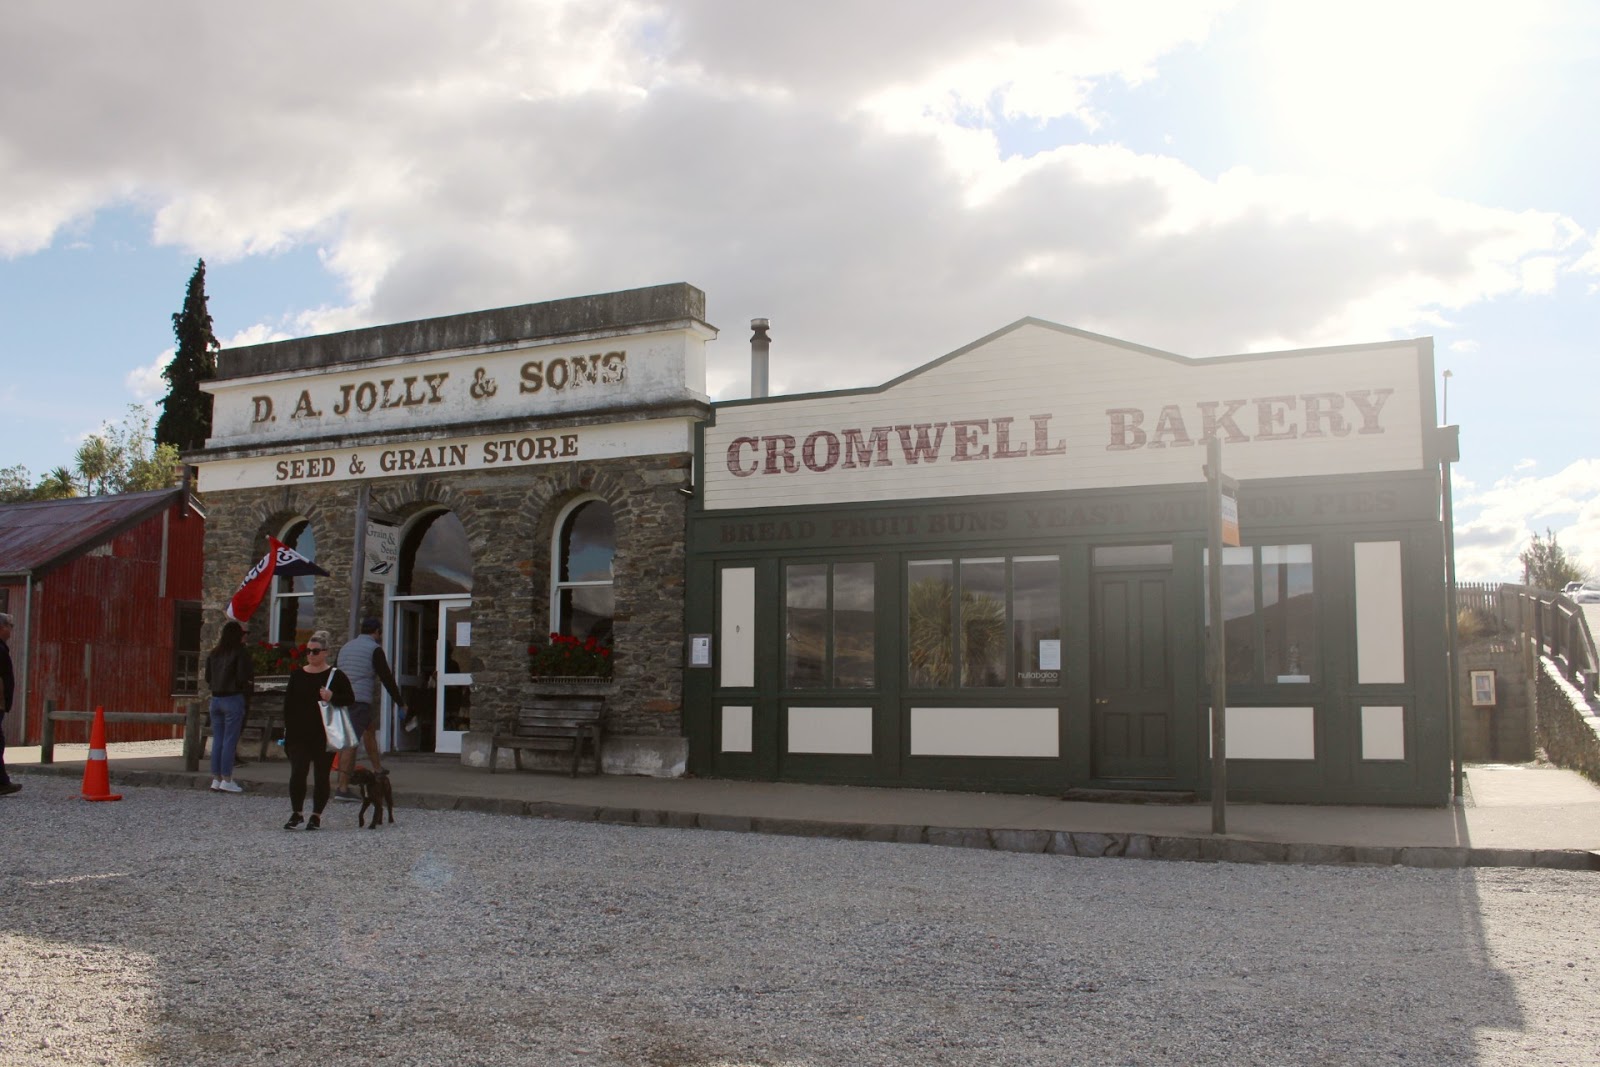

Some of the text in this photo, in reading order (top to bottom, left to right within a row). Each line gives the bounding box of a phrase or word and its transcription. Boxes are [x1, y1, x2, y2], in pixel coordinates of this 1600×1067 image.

[252, 351, 627, 423] D. A. JOLLY & SONS
[276, 434, 579, 481] SEED & GRAIN STORE
[727, 389, 1395, 477] CROMWELL BAKERY
[366, 524, 387, 539] Grain
[719, 521, 816, 544] BREAD
[831, 514, 920, 538] FRUIT
[928, 510, 1009, 534] BUNS
[1024, 503, 1131, 529] YEAST
[1145, 493, 1296, 525] MUON
[1311, 489, 1400, 515] PIES
[380, 541, 398, 555] Seed
